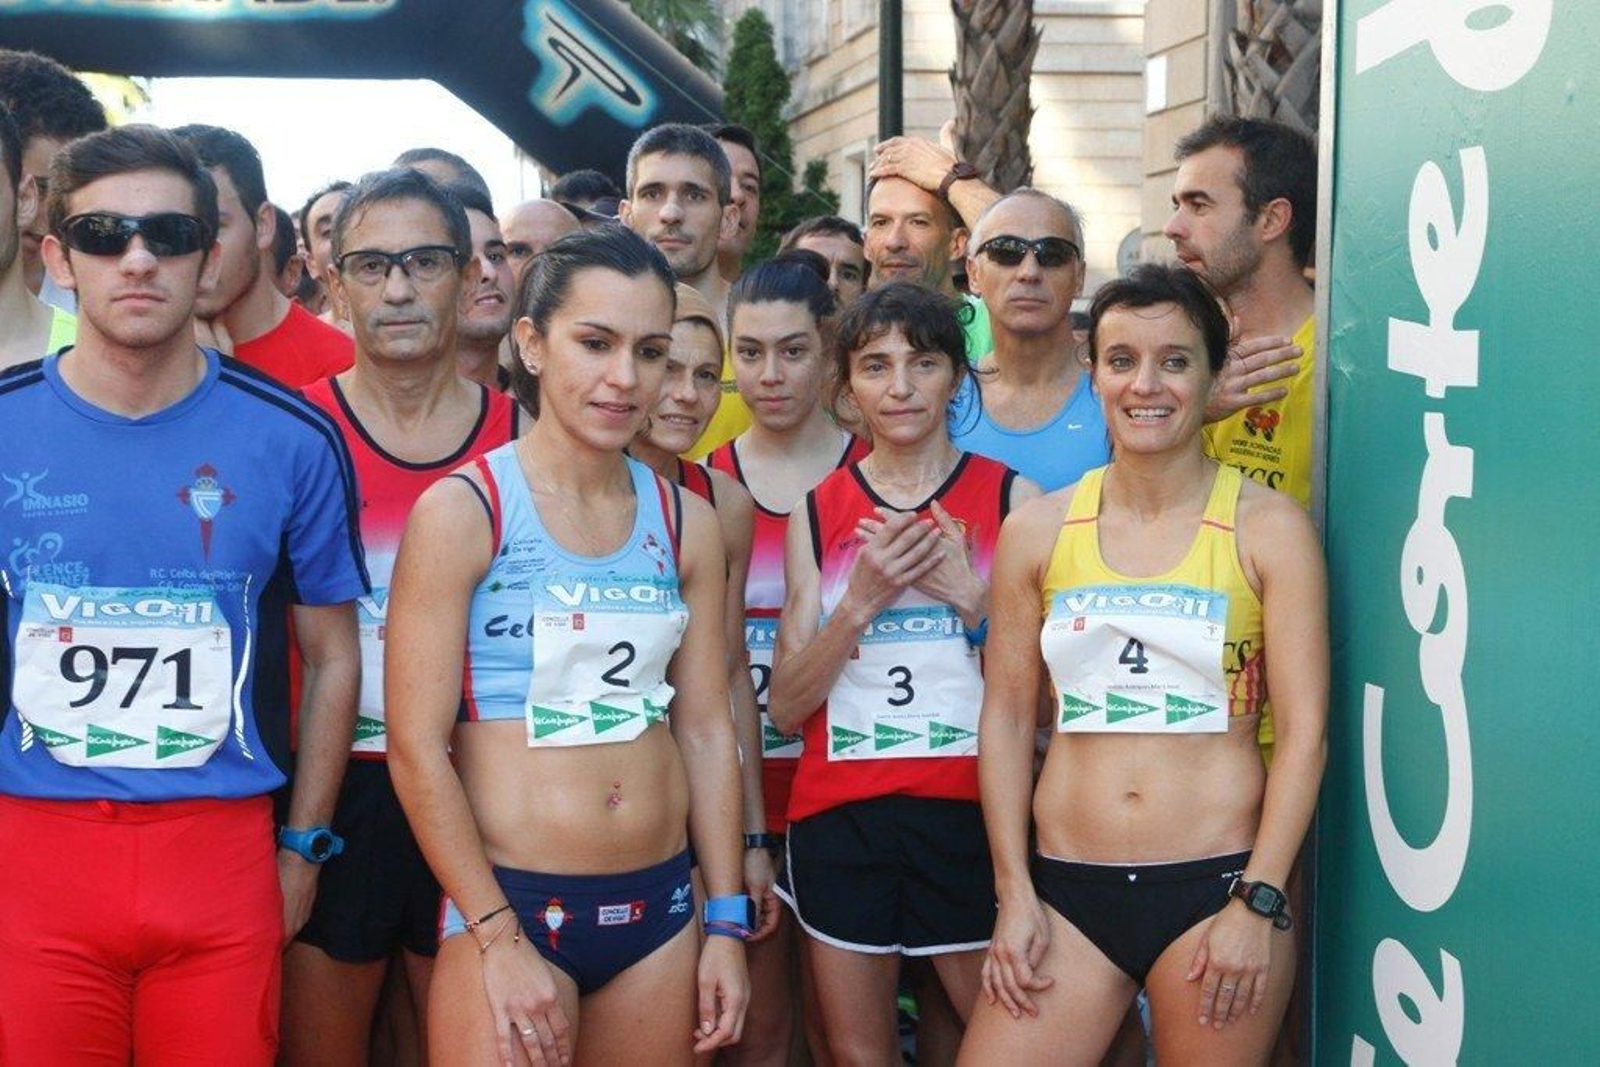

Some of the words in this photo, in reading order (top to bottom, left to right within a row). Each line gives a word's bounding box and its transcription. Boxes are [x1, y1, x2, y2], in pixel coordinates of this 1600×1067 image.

[1365, 146, 1489, 913] Corte
[59, 645, 203, 710] 971
[601, 641, 636, 687] 2
[1118, 637, 1149, 674] 4
[887, 666, 915, 706] 3
